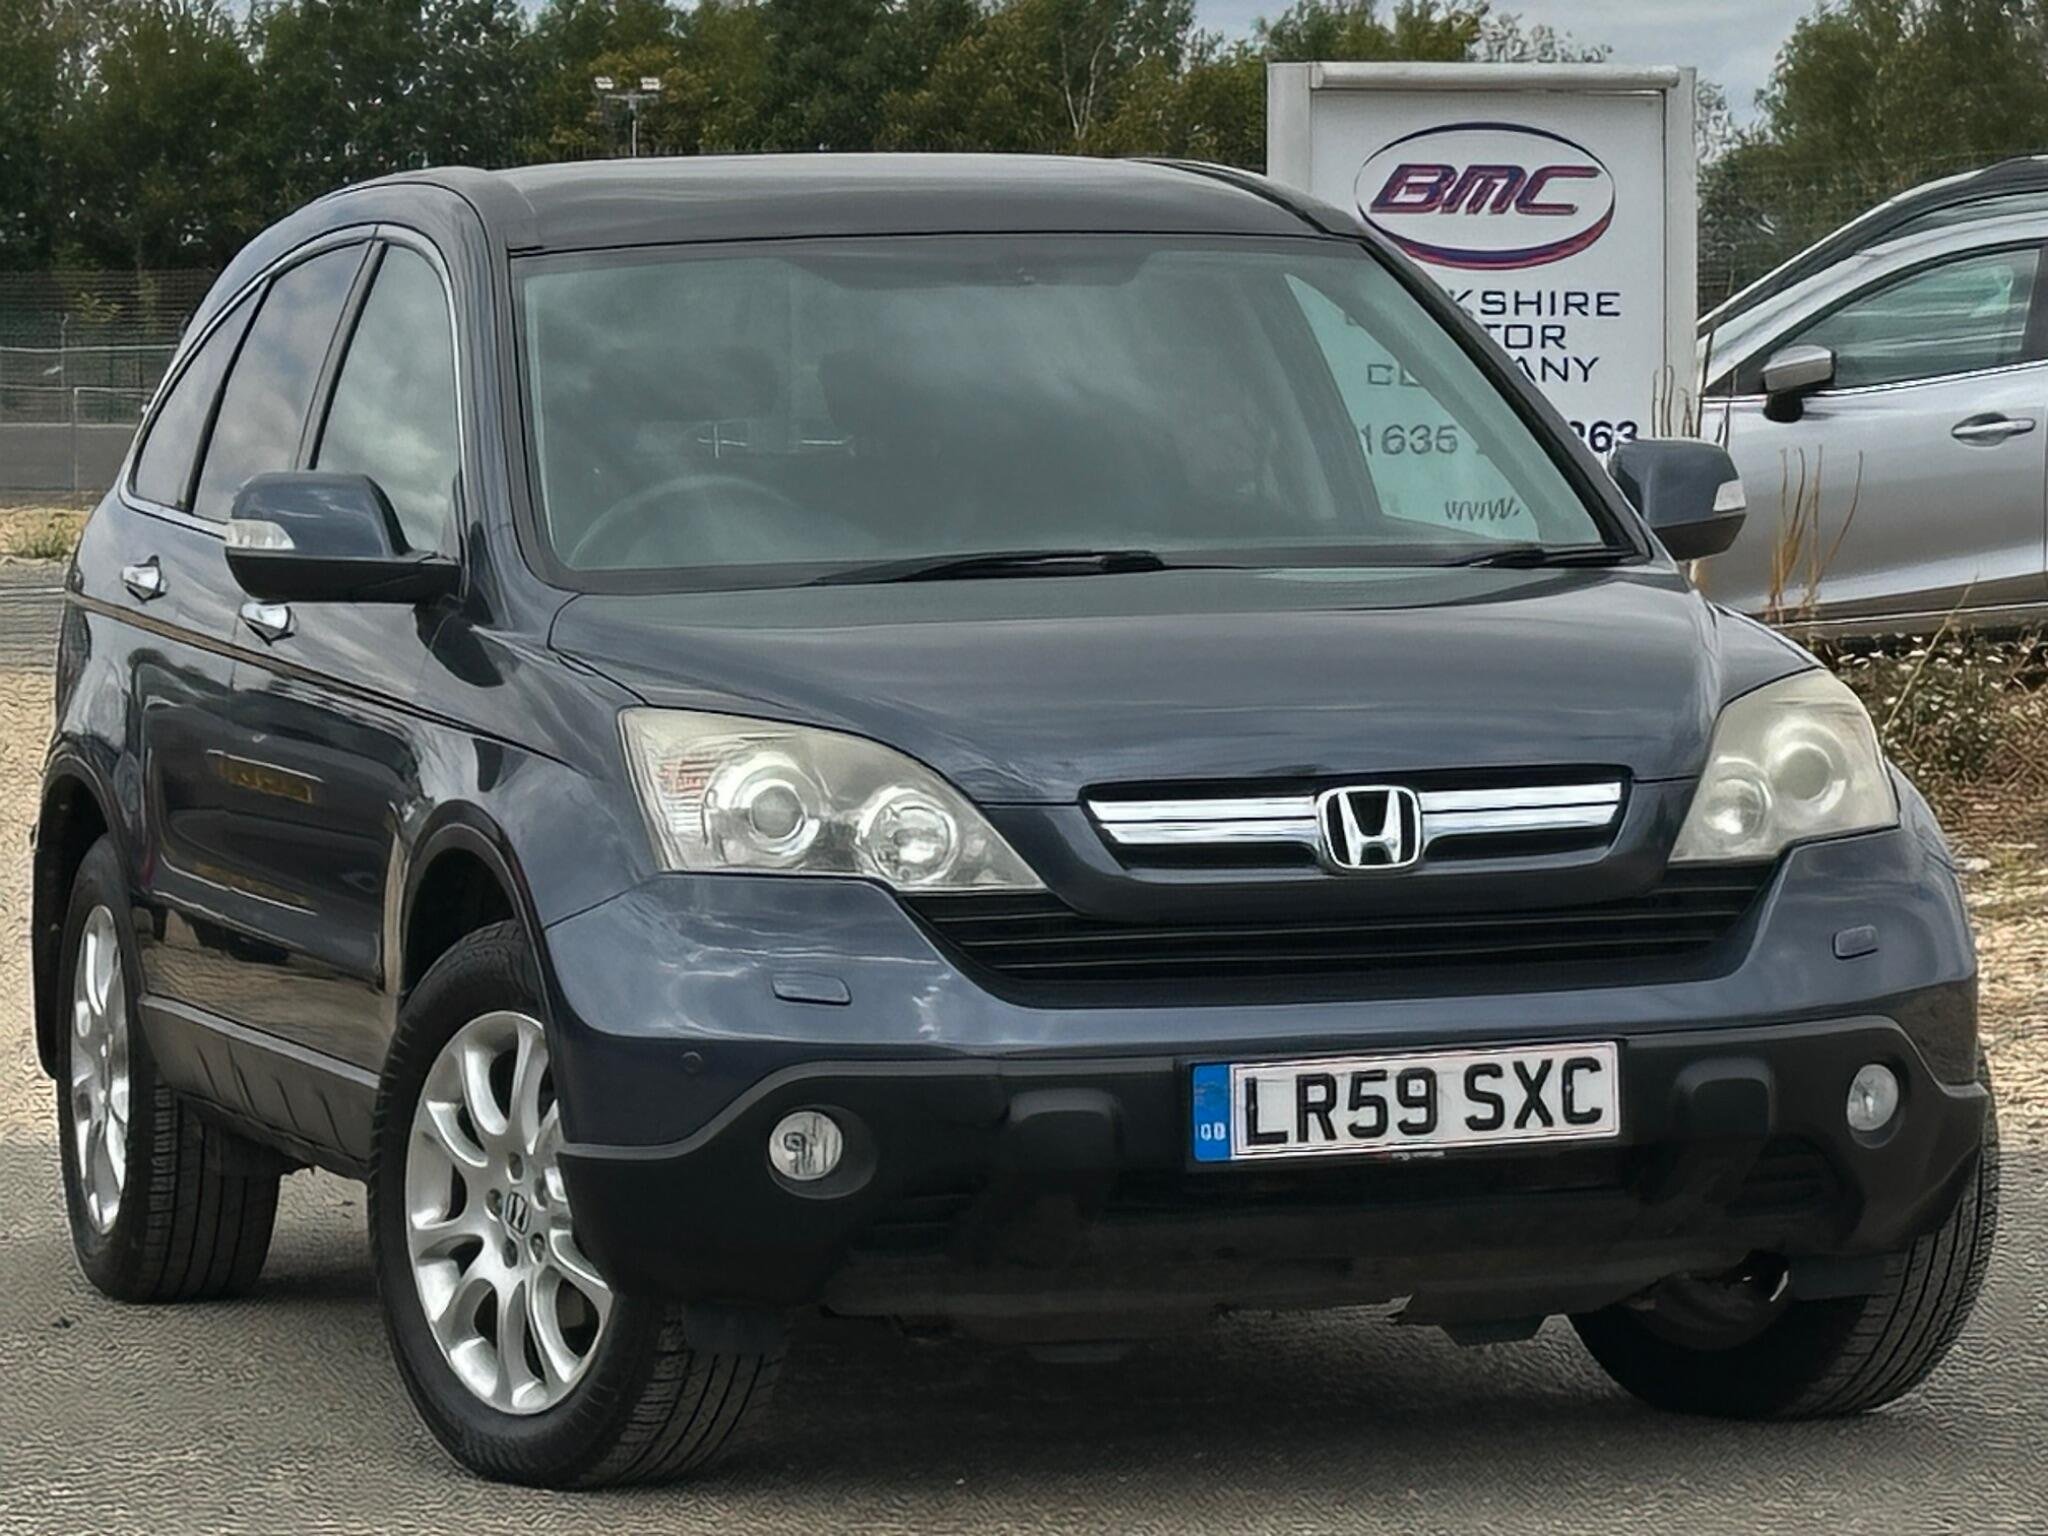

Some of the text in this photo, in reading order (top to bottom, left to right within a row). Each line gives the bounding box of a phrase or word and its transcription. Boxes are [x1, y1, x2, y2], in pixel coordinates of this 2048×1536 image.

[1370, 163, 1601, 216] BMC
[1361, 423, 1459, 455] 1635
[1244, 1055, 1604, 1147] LR59 SXC
